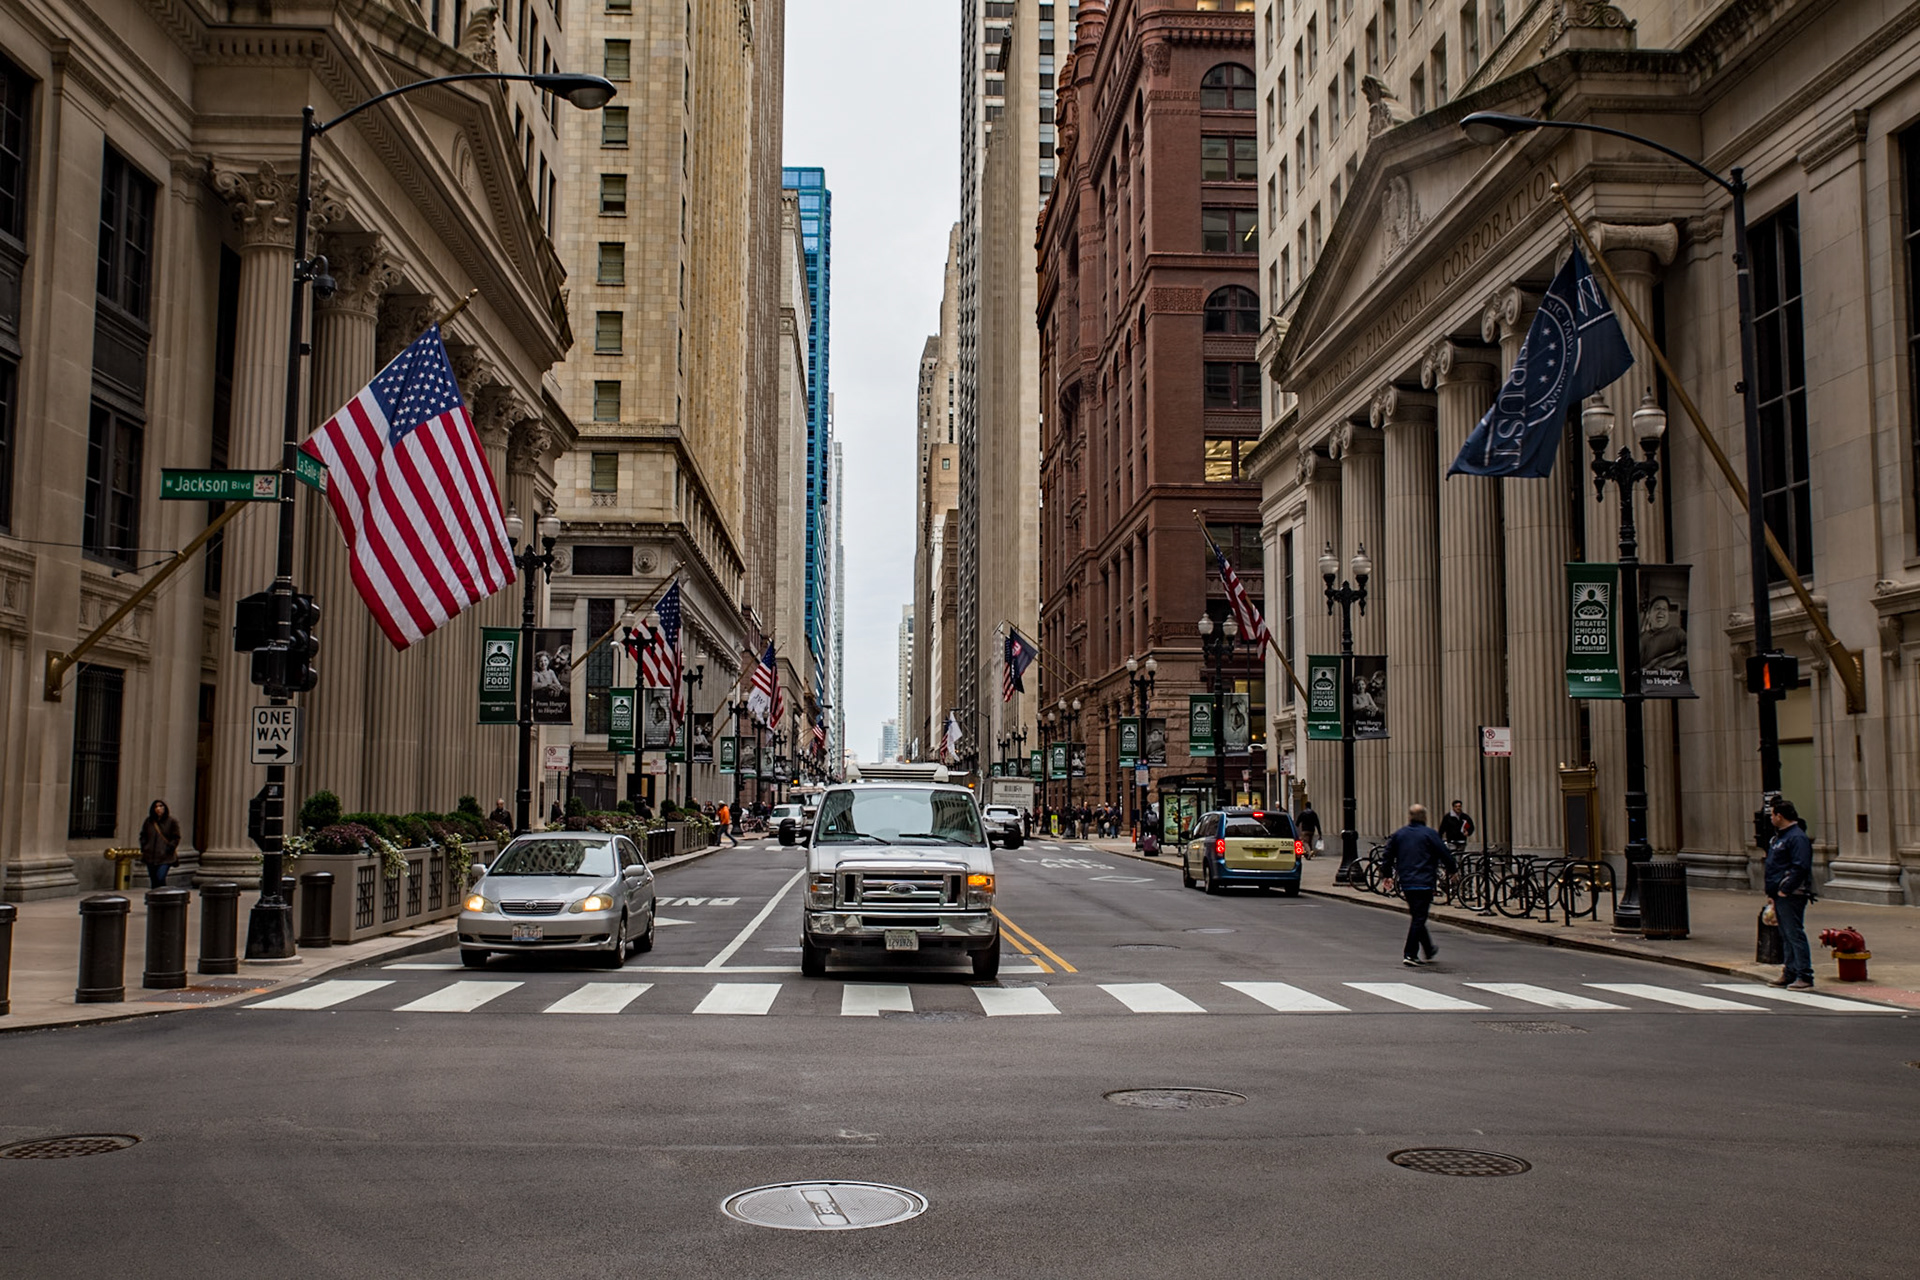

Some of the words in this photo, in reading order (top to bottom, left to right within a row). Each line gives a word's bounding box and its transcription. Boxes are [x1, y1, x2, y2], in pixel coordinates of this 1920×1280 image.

[1309, 346, 1359, 403] WINTRUST
[1365, 280, 1432, 357] FINANCIAL
[1442, 156, 1559, 286] CORPORATION
[297, 456, 304, 473] La
[166, 480, 173, 488] W
[174, 476, 228, 493] Jackson
[231, 481, 251, 490] Blvd
[1574, 635, 1607, 645] FOOD
[1660, 668, 1683, 678] Hungry
[258, 711, 291, 725] ONE
[257, 727, 292, 741] WAY
